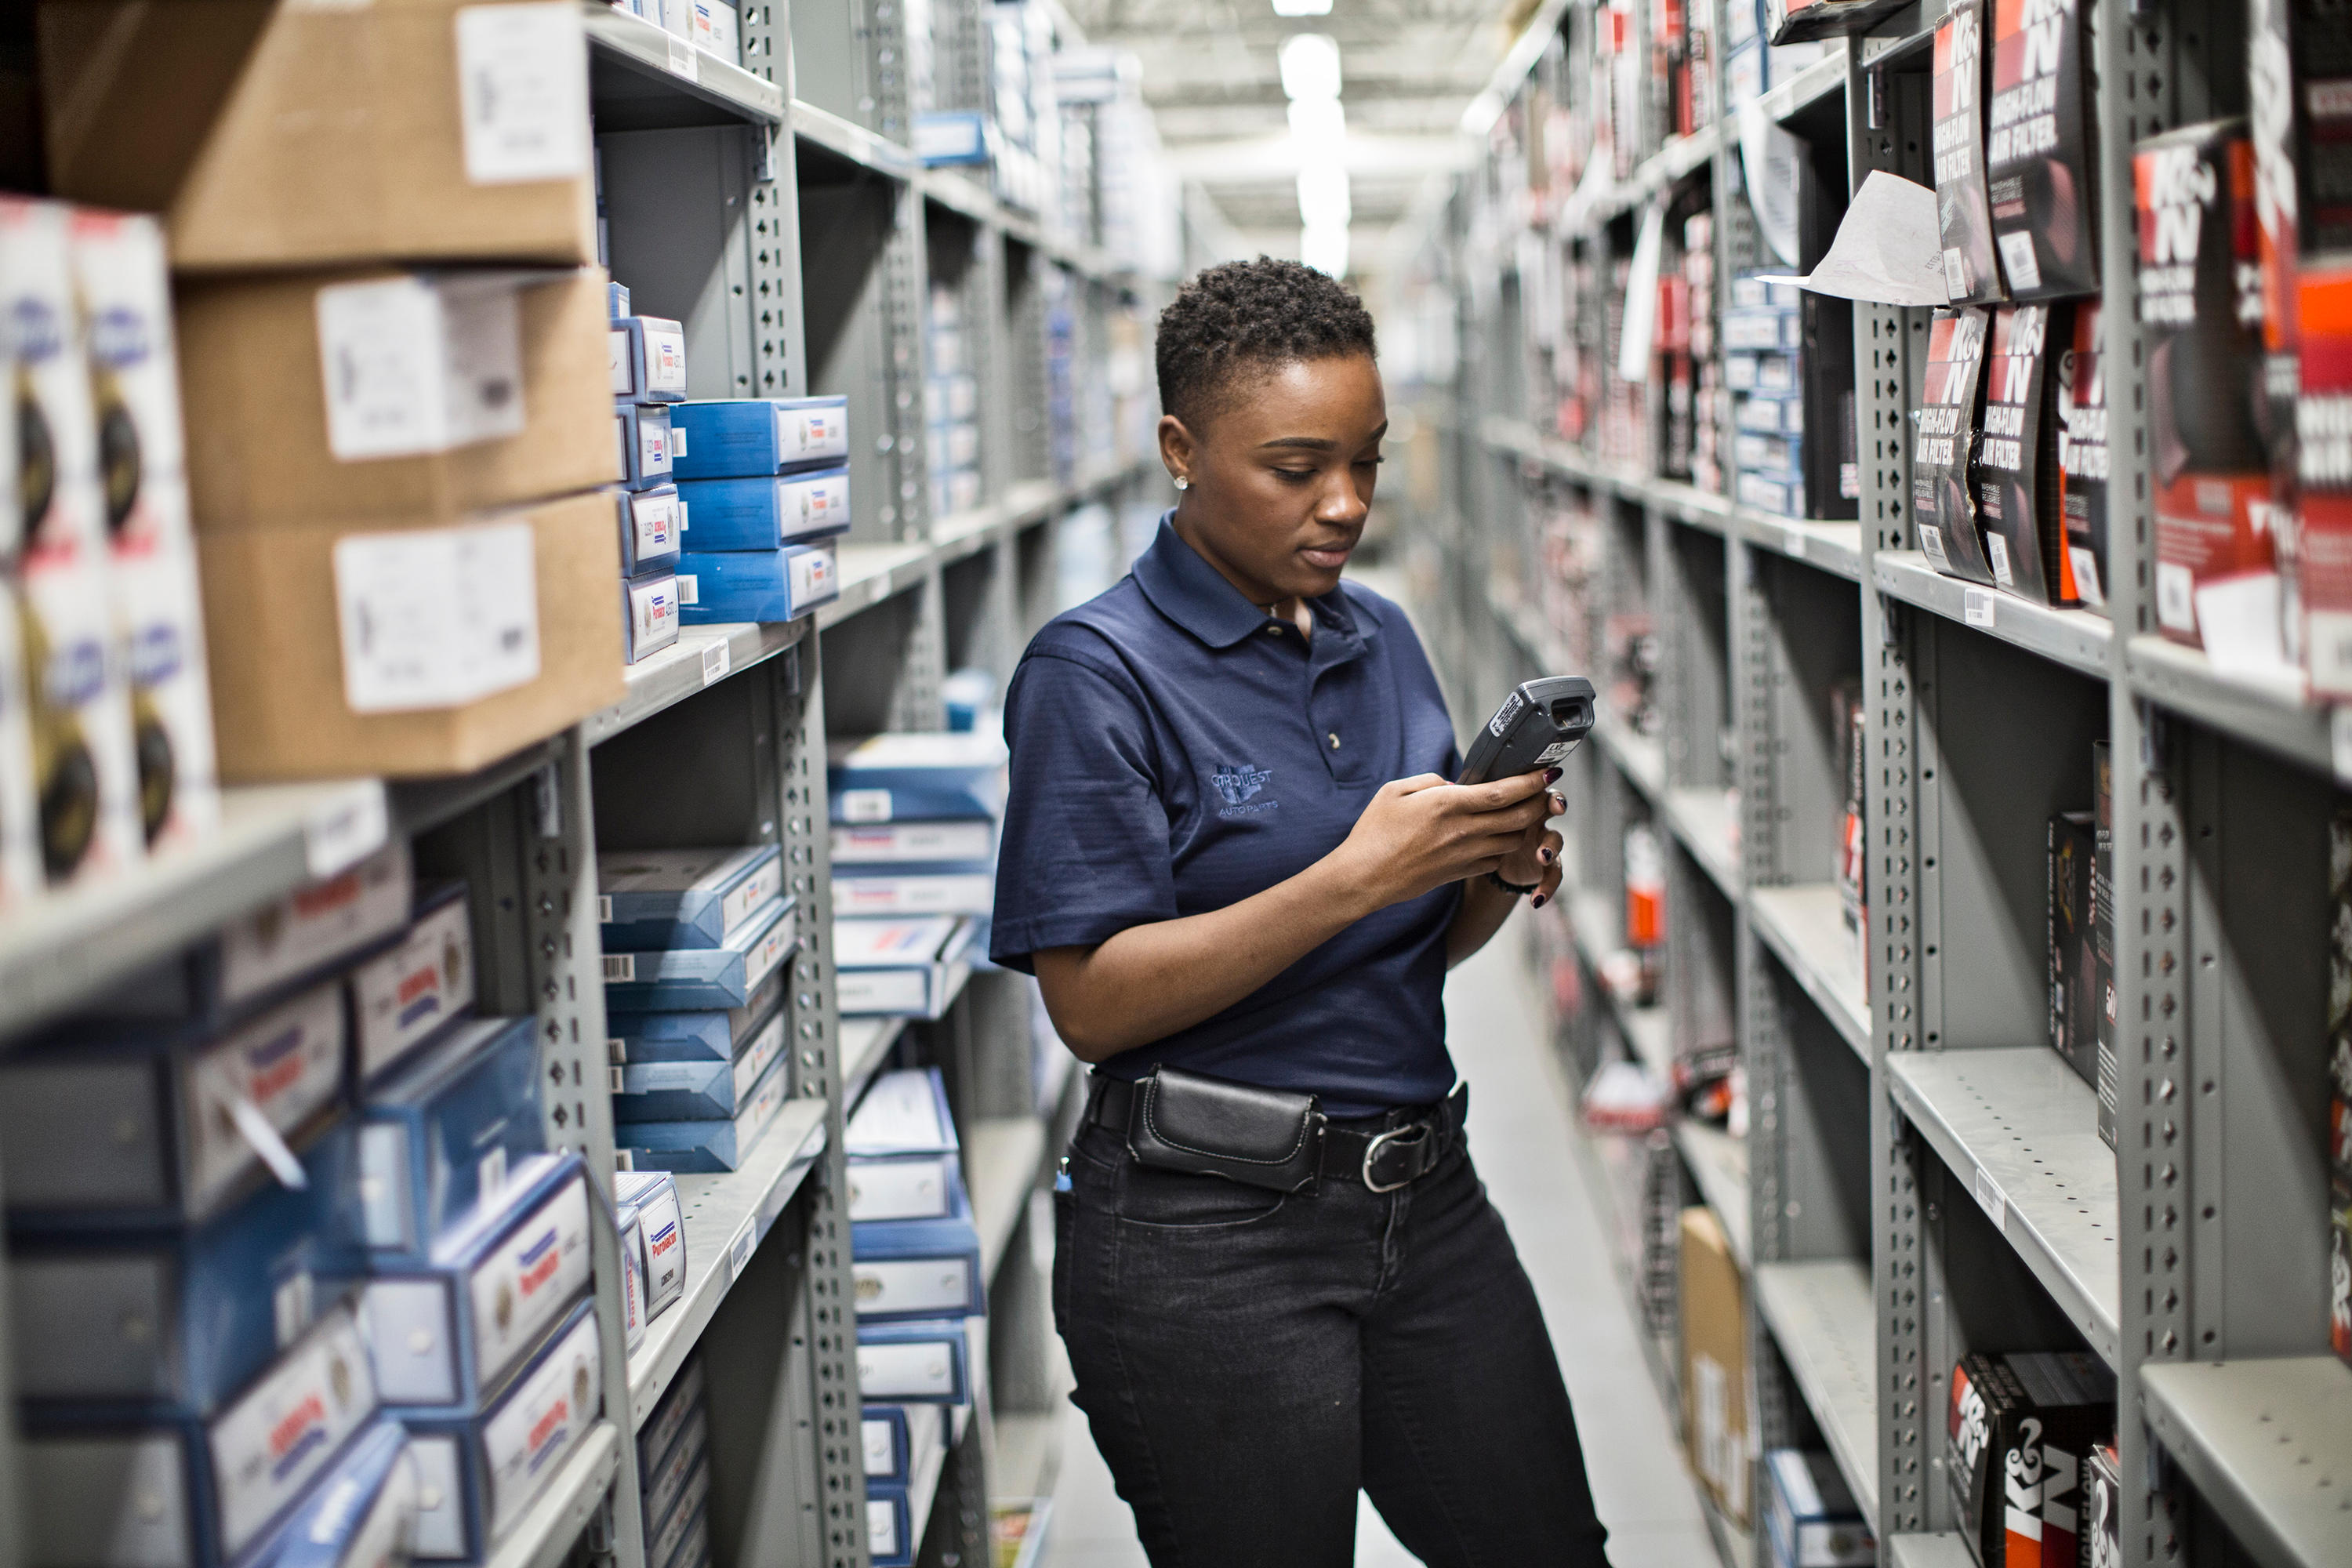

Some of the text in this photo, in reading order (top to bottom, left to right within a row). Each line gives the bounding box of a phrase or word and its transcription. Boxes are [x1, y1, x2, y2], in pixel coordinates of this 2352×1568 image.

[1920, 408, 1960, 434] HIGH-FLOW
[1984, 405, 2026, 437] HIGH-FLOW
[1916, 437, 1929, 463] AIR
[1982, 437, 1995, 466] AIR
[1211, 770, 1272, 787] CARQUEST
[1219, 800, 1279, 816] AUTO PARTS
[652, 1231, 677, 1259] Purolator
